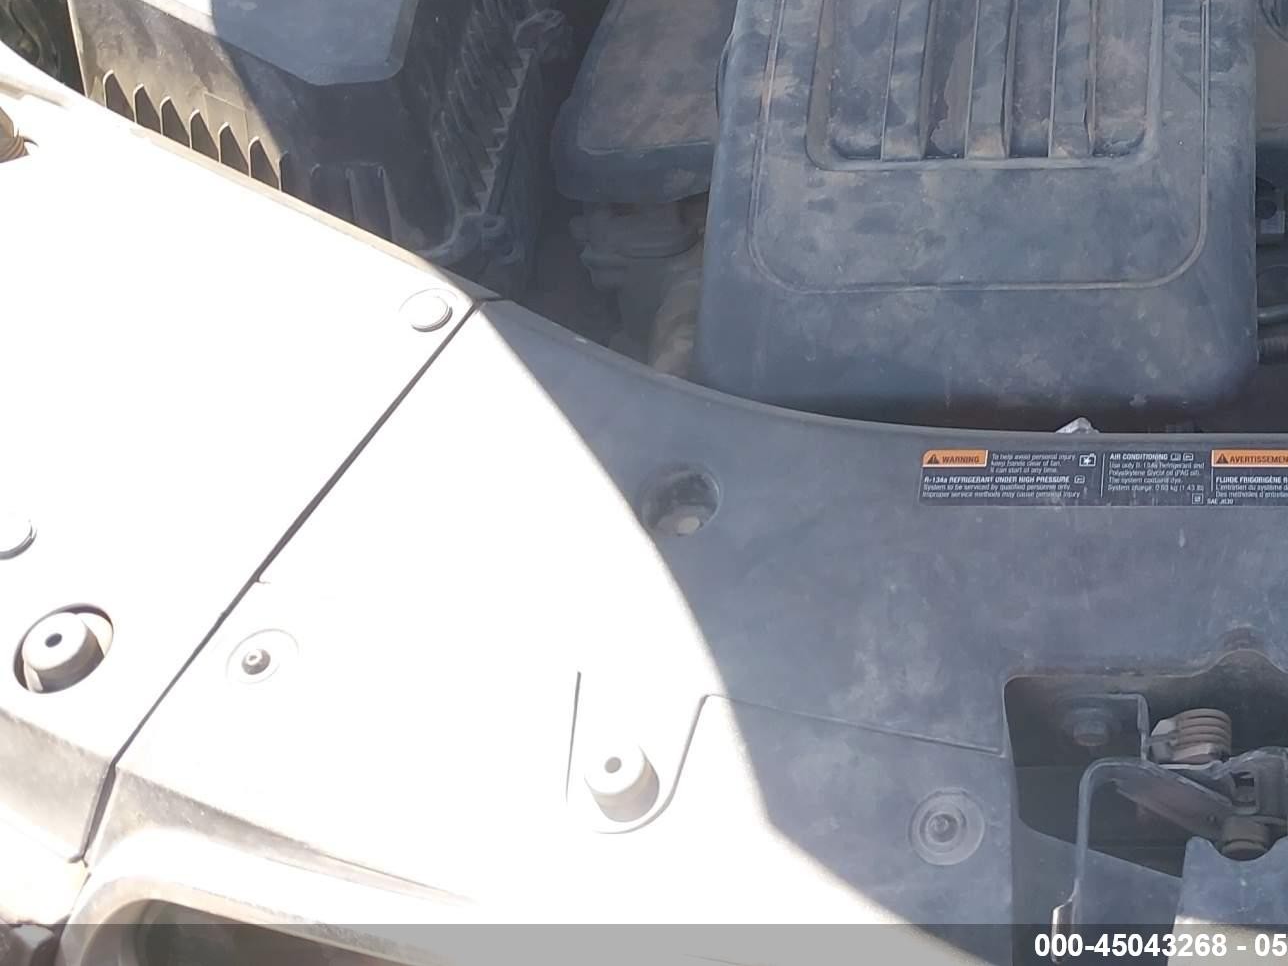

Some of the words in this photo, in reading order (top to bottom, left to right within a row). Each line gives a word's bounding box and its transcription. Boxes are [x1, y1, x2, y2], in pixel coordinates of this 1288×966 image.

[942, 455, 979, 464] WARNING
[1031, 453, 1058, 461] personal
[1215, 475, 1238, 483] FLUIDE
